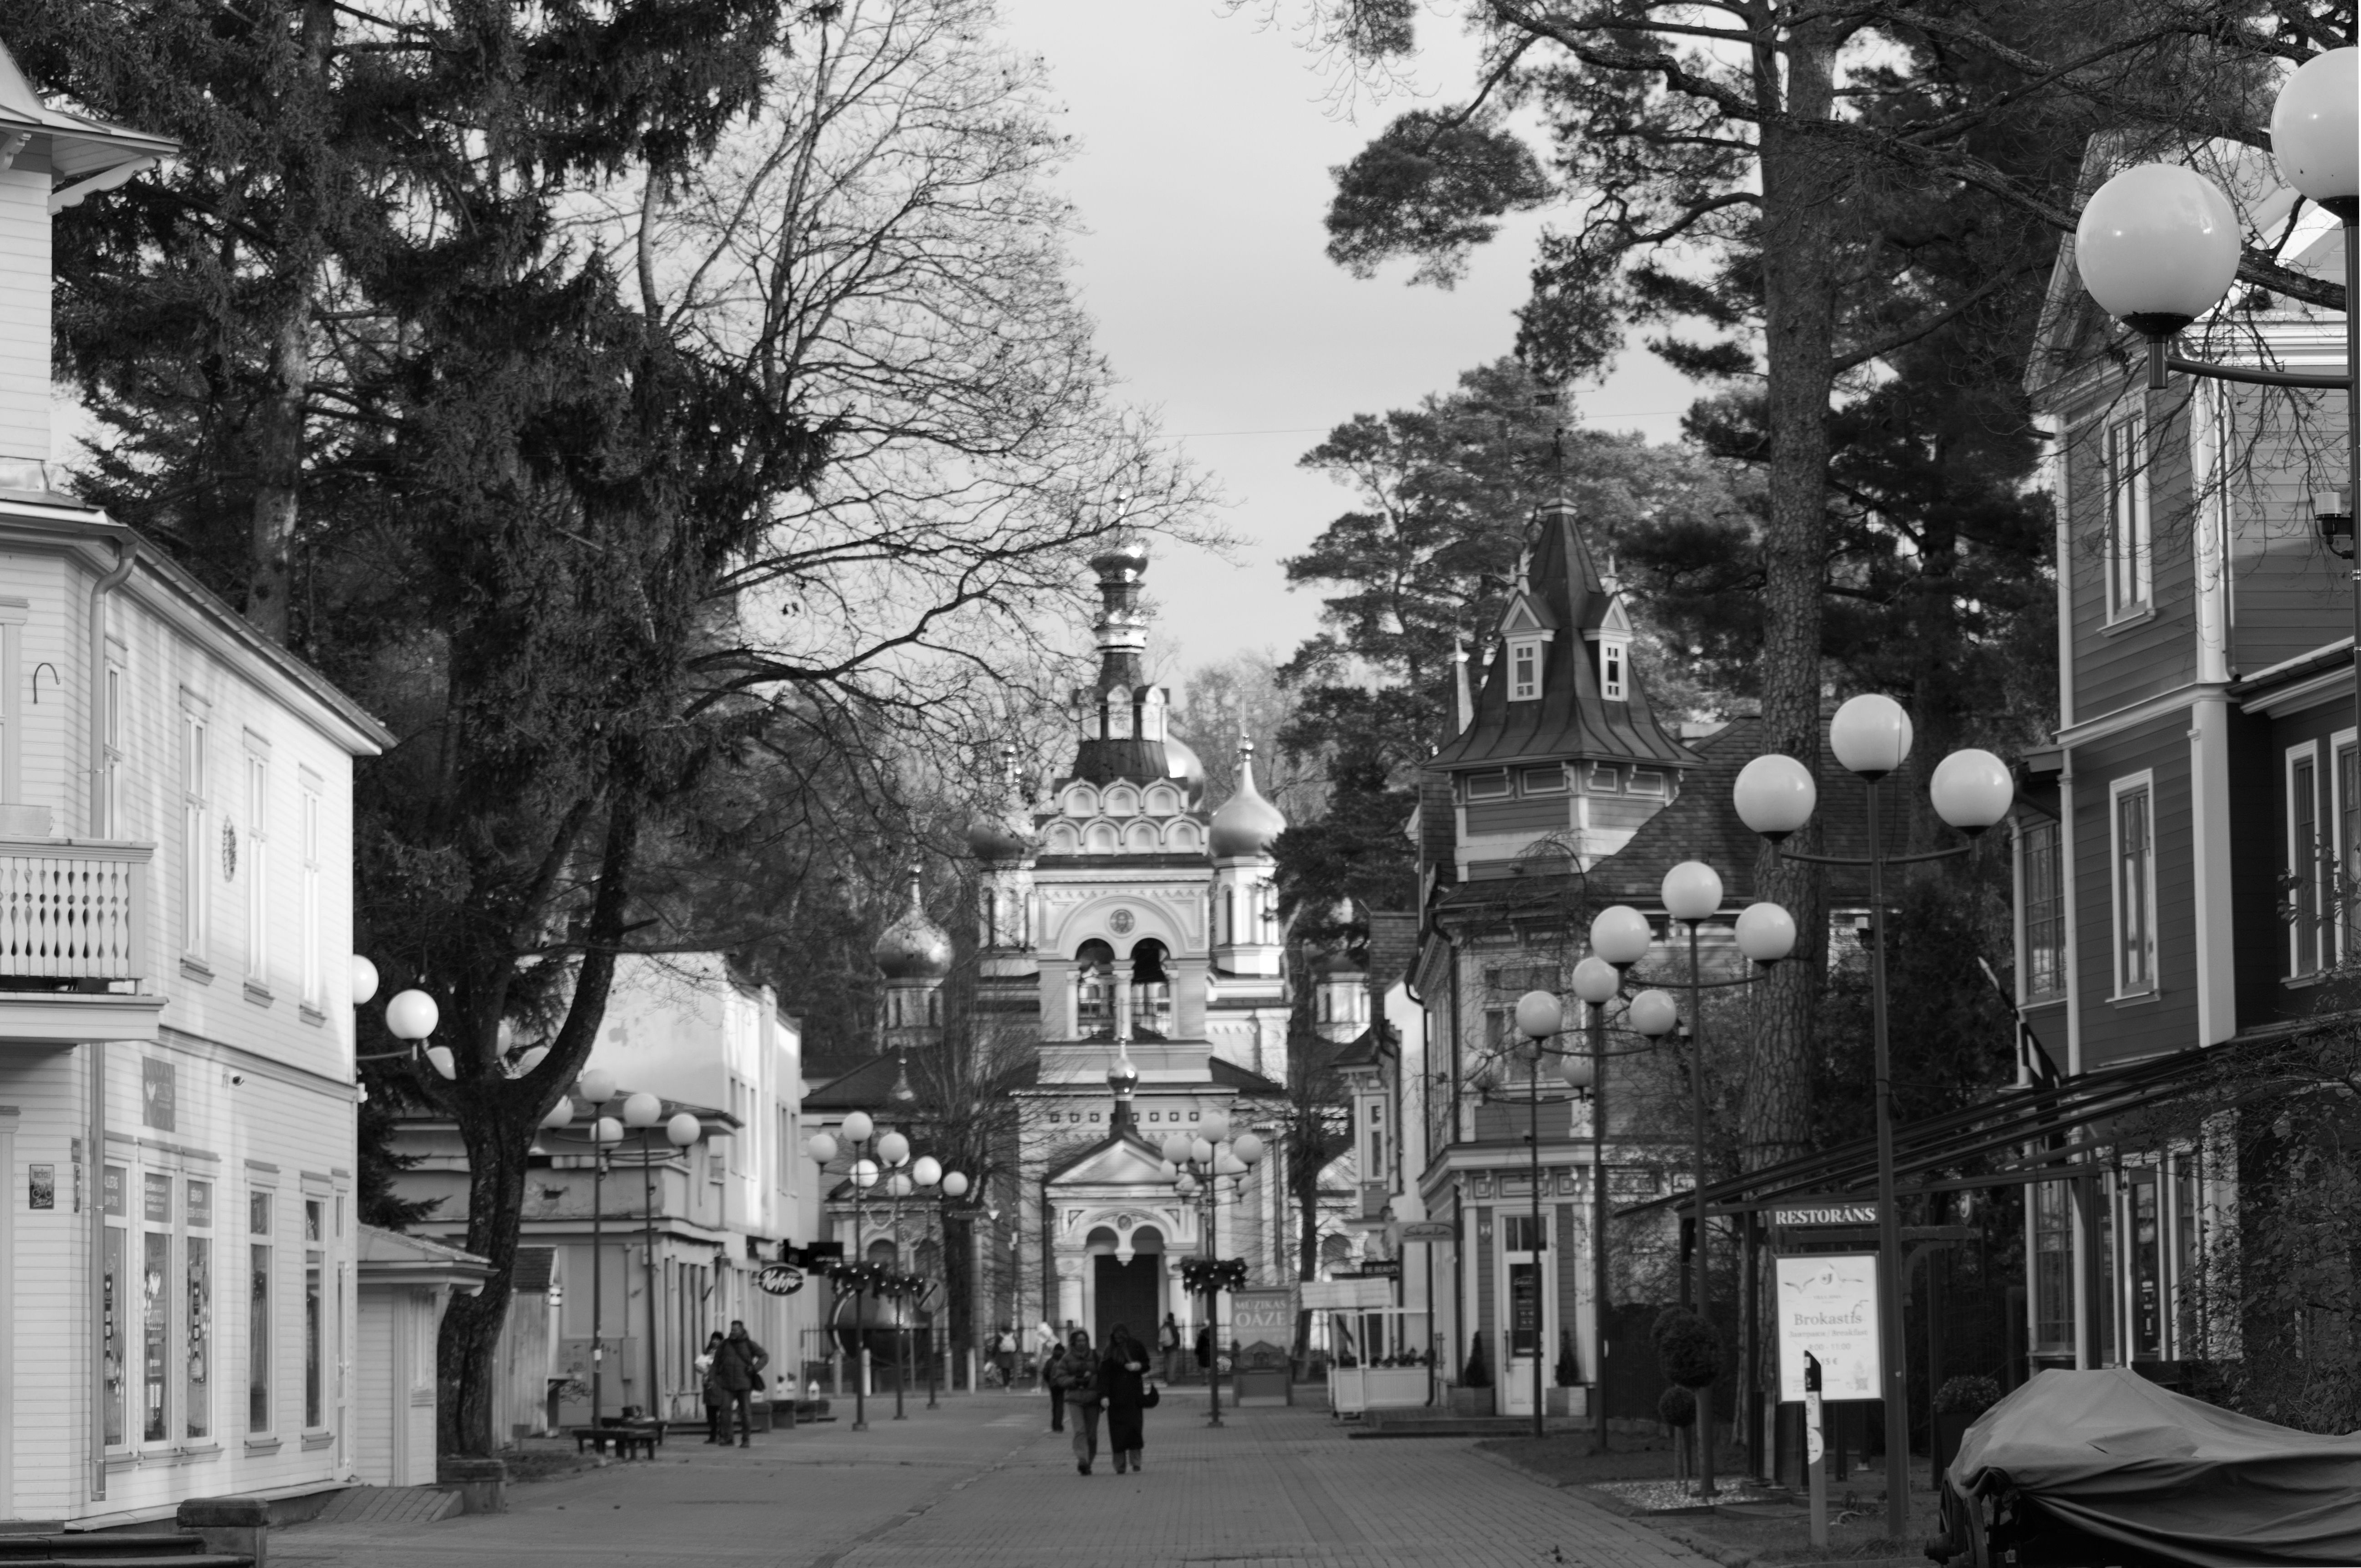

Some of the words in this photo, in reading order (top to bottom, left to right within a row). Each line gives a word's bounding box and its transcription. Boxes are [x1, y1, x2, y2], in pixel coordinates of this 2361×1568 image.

[1775, 1206, 1876, 1225] RESTORĀNS
[1234, 1299, 1286, 1310] MŪZIKAS
[1235, 1309, 1286, 1327] OĀZE
[1794, 1312, 1862, 1326] Brokastis
[1832, 1329, 1869, 1338] Breakfast
